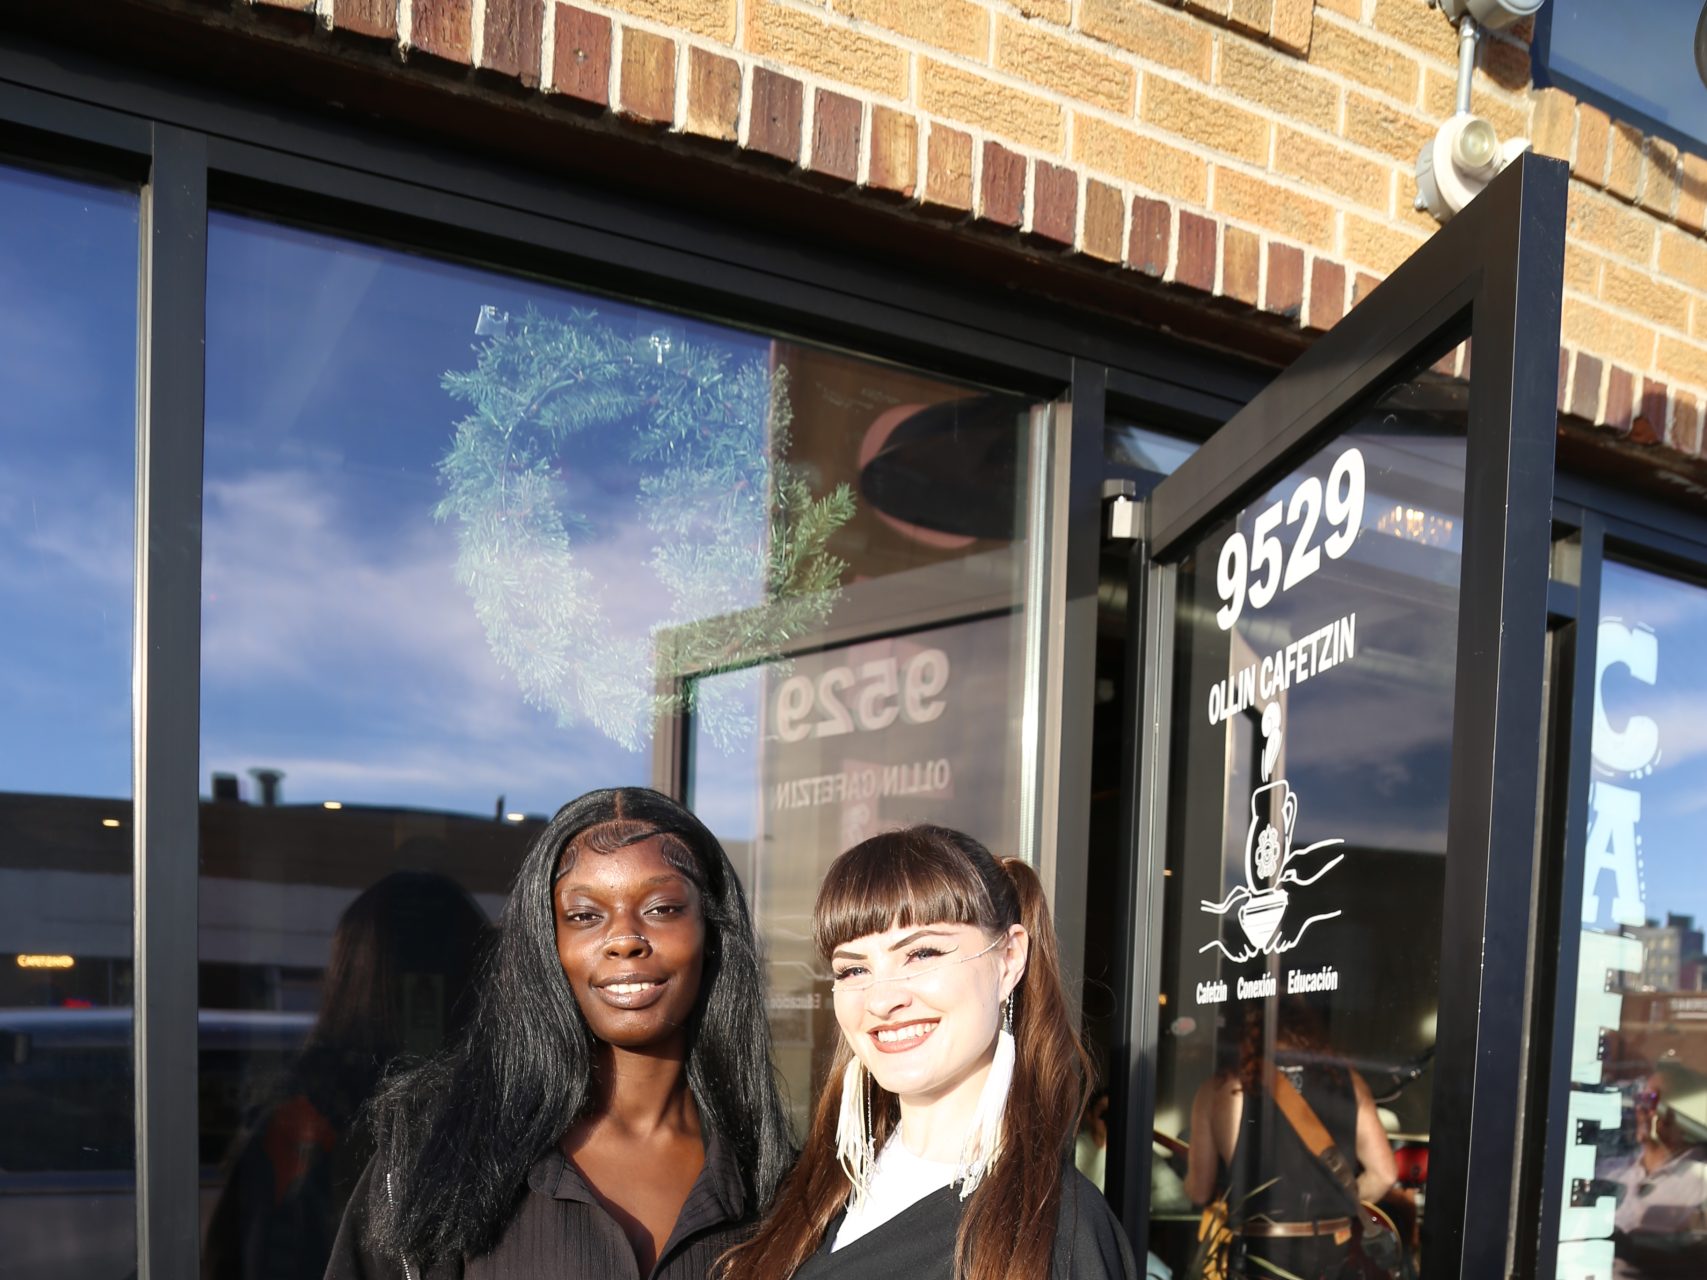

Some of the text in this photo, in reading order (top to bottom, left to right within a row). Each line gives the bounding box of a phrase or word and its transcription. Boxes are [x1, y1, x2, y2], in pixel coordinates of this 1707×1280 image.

[1216, 447, 1366, 631] 9529
[1208, 612, 1356, 726] OLLIN CAFETZIN
[1196, 965, 1339, 1005] Cafetzin Conexión Educación
